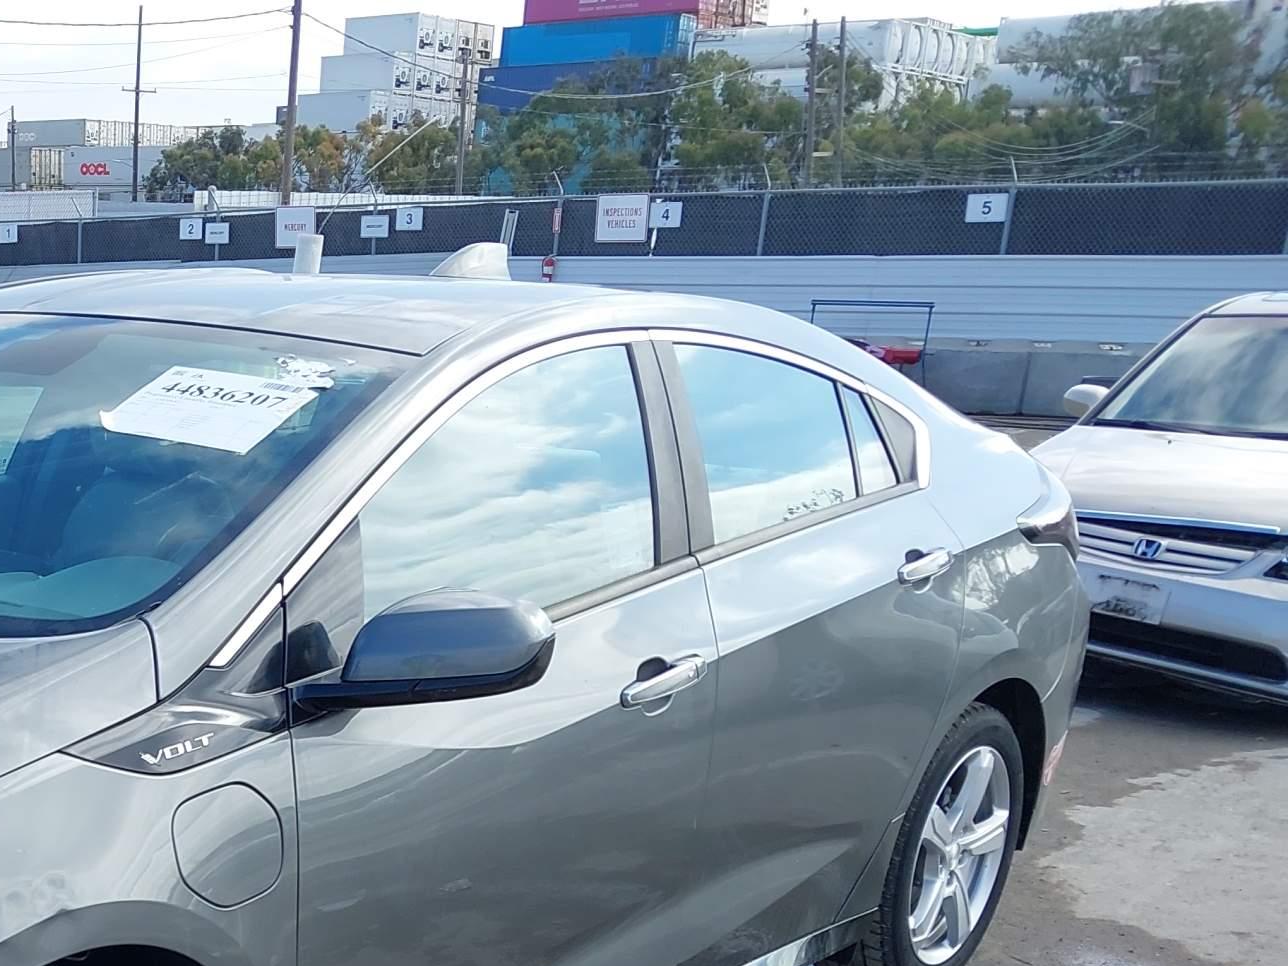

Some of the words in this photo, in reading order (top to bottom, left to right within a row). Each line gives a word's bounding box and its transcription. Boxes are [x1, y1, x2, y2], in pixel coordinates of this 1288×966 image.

[80, 163, 110, 175] OOCL
[602, 207, 642, 217] INSPECTIONS
[982, 201, 992, 215] 5
[406, 213, 413, 225] 3
[661, 208, 670, 221] 4
[187, 223, 195, 235] 2
[284, 223, 307, 232] MERCURY
[607, 219, 636, 229] VEHICLES
[161, 382, 289, 409] 44836207
[139, 732, 214, 765] VOLT
